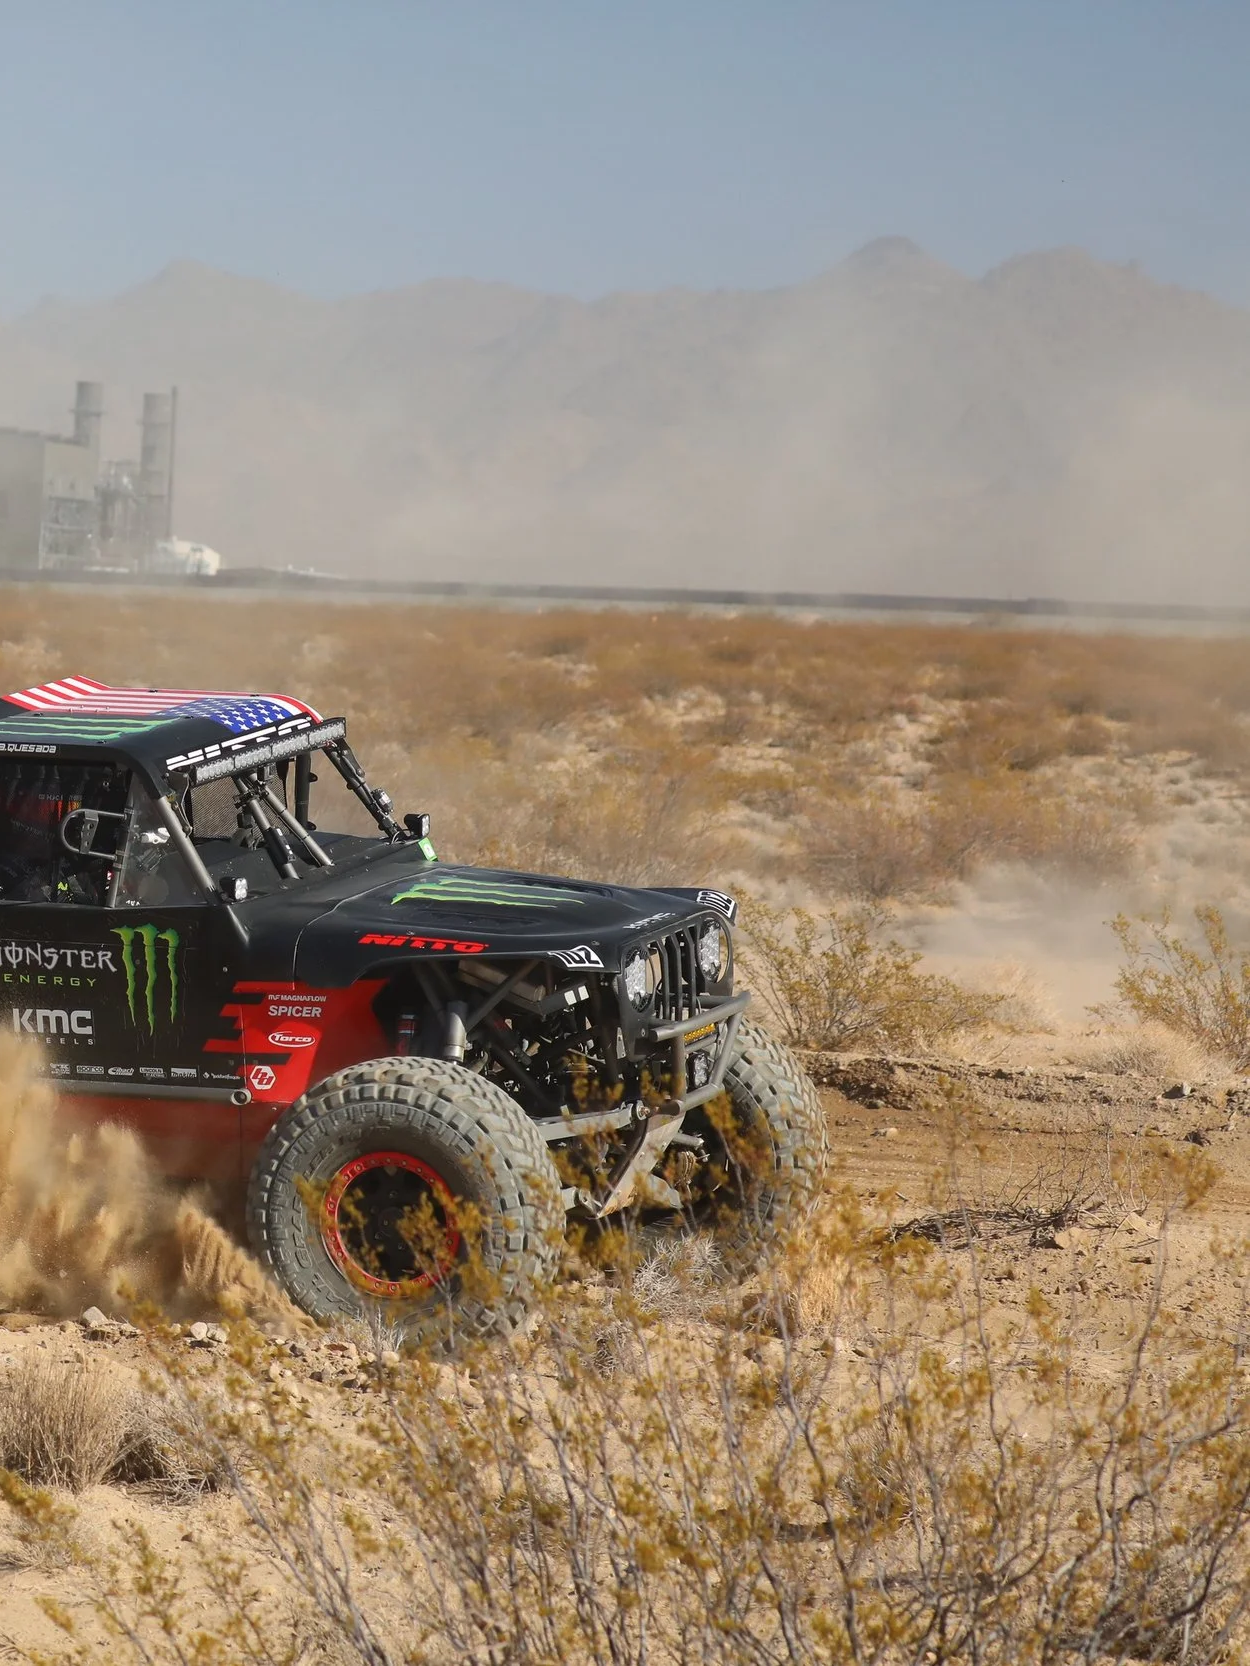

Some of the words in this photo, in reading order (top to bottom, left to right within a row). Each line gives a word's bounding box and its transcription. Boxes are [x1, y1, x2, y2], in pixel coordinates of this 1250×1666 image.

[358, 933, 485, 954] NITTO
[3, 973, 96, 987] ENERGY
[281, 995, 327, 1003] MAGNAFLOW
[268, 1005, 322, 1018] SPICER
[14, 1037, 94, 1046] EELS
